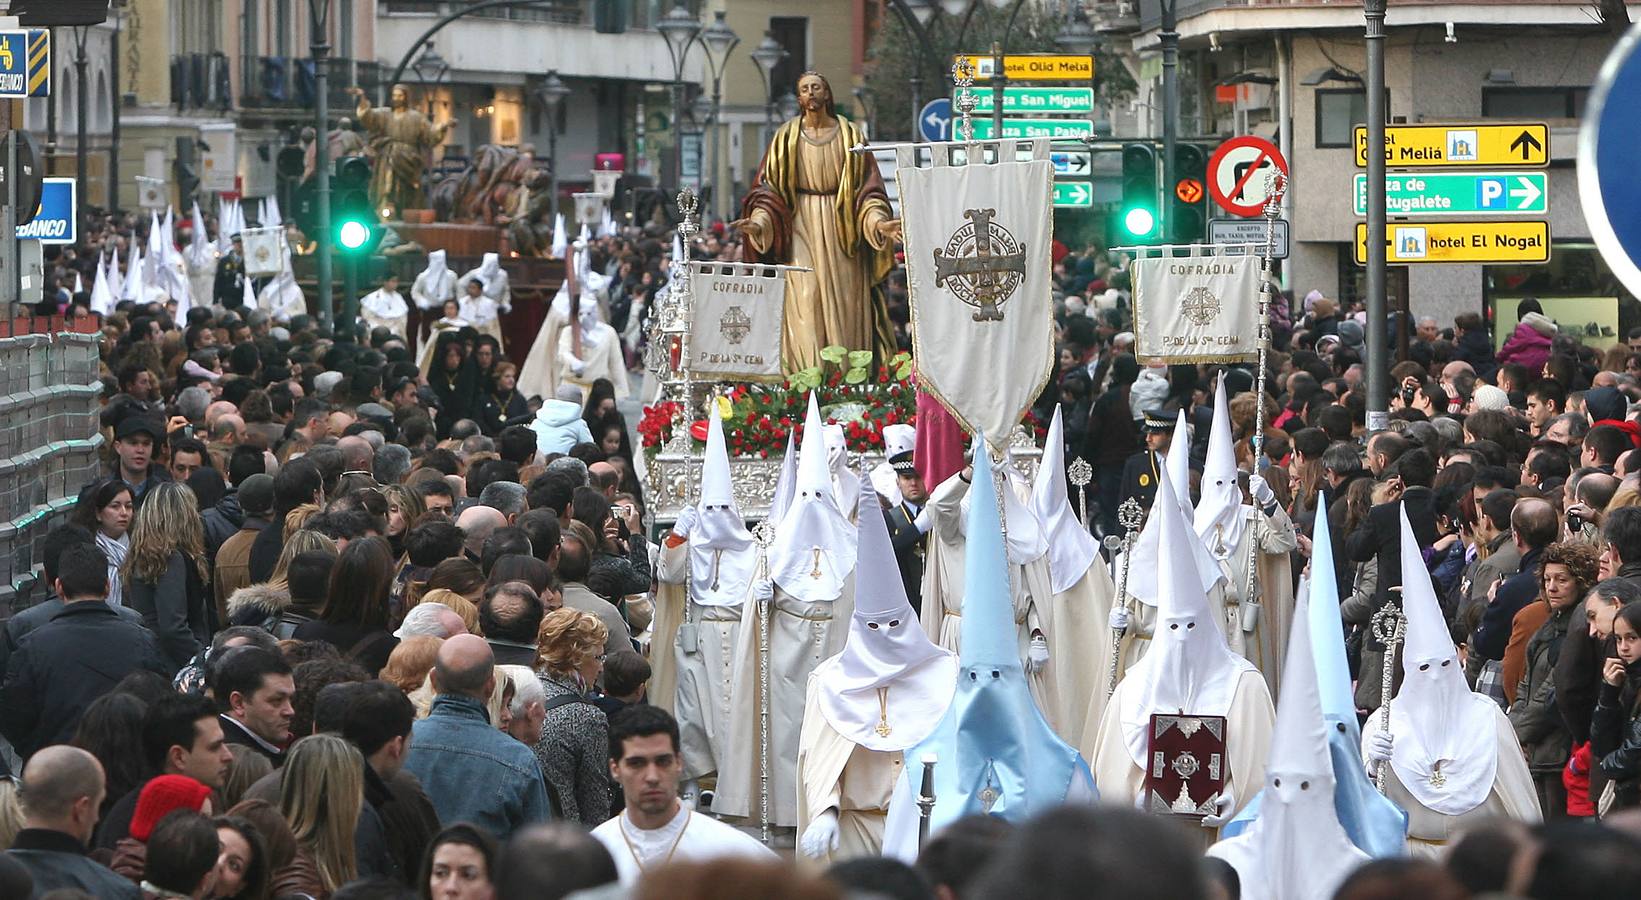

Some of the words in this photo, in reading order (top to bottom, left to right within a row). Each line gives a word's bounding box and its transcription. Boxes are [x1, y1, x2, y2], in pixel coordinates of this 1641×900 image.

[1029, 62, 1054, 72] Olid
[1020, 94, 1046, 106] San
[1048, 93, 1090, 109] Miguel
[1025, 126, 1051, 137] San
[1360, 133, 1396, 145] hel
[1360, 148, 1393, 160] Od
[1400, 146, 1443, 160] Meliá
[1359, 180, 1402, 195] pza
[1405, 178, 1426, 191] de
[1481, 180, 1503, 207] P
[1359, 194, 1452, 212] Ptugalete
[1430, 236, 1466, 249] hotel
[1472, 235, 1488, 248] El
[1495, 234, 1542, 251] Nogal
[1170, 264, 1235, 276] COFRADIA
[713, 281, 764, 295] COFRADIA
[1173, 336, 1185, 345] DE
[1188, 336, 1198, 345] LA
[1217, 335, 1239, 345] CENA
[744, 355, 765, 366] CENA
